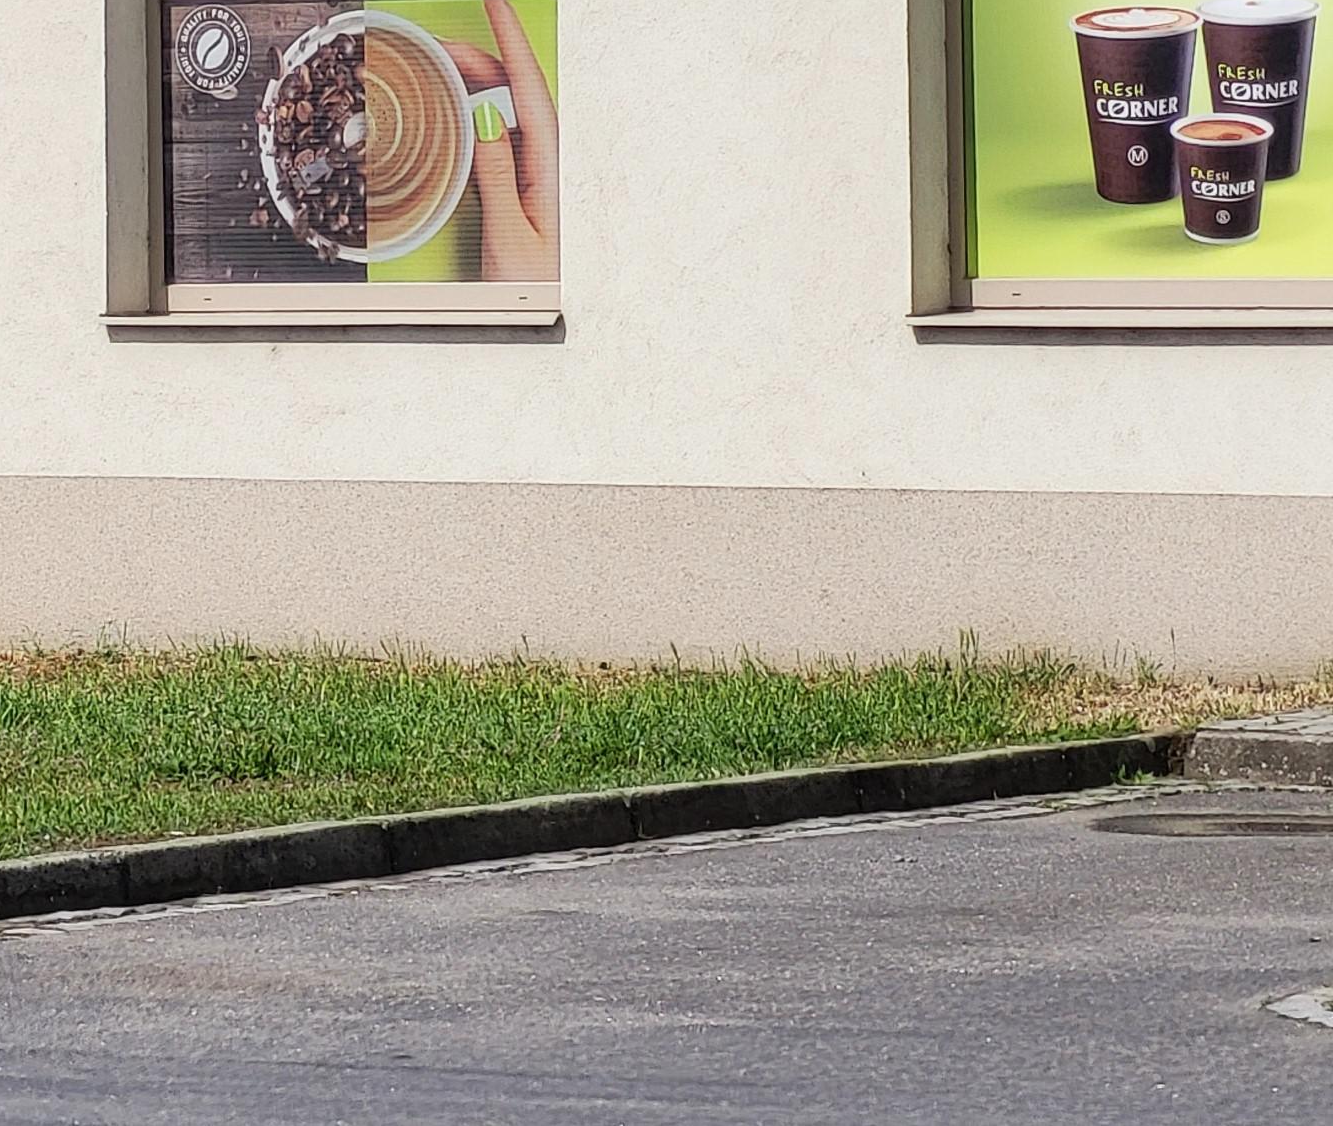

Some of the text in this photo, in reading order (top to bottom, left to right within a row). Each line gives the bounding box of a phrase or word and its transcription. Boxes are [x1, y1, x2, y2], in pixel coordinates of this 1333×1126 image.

[1220, 80, 1299, 101] CORNER
[1096, 96, 1179, 119] CORNER
[1129, 148, 1146, 164] M
[1191, 180, 1256, 197] CORNER
